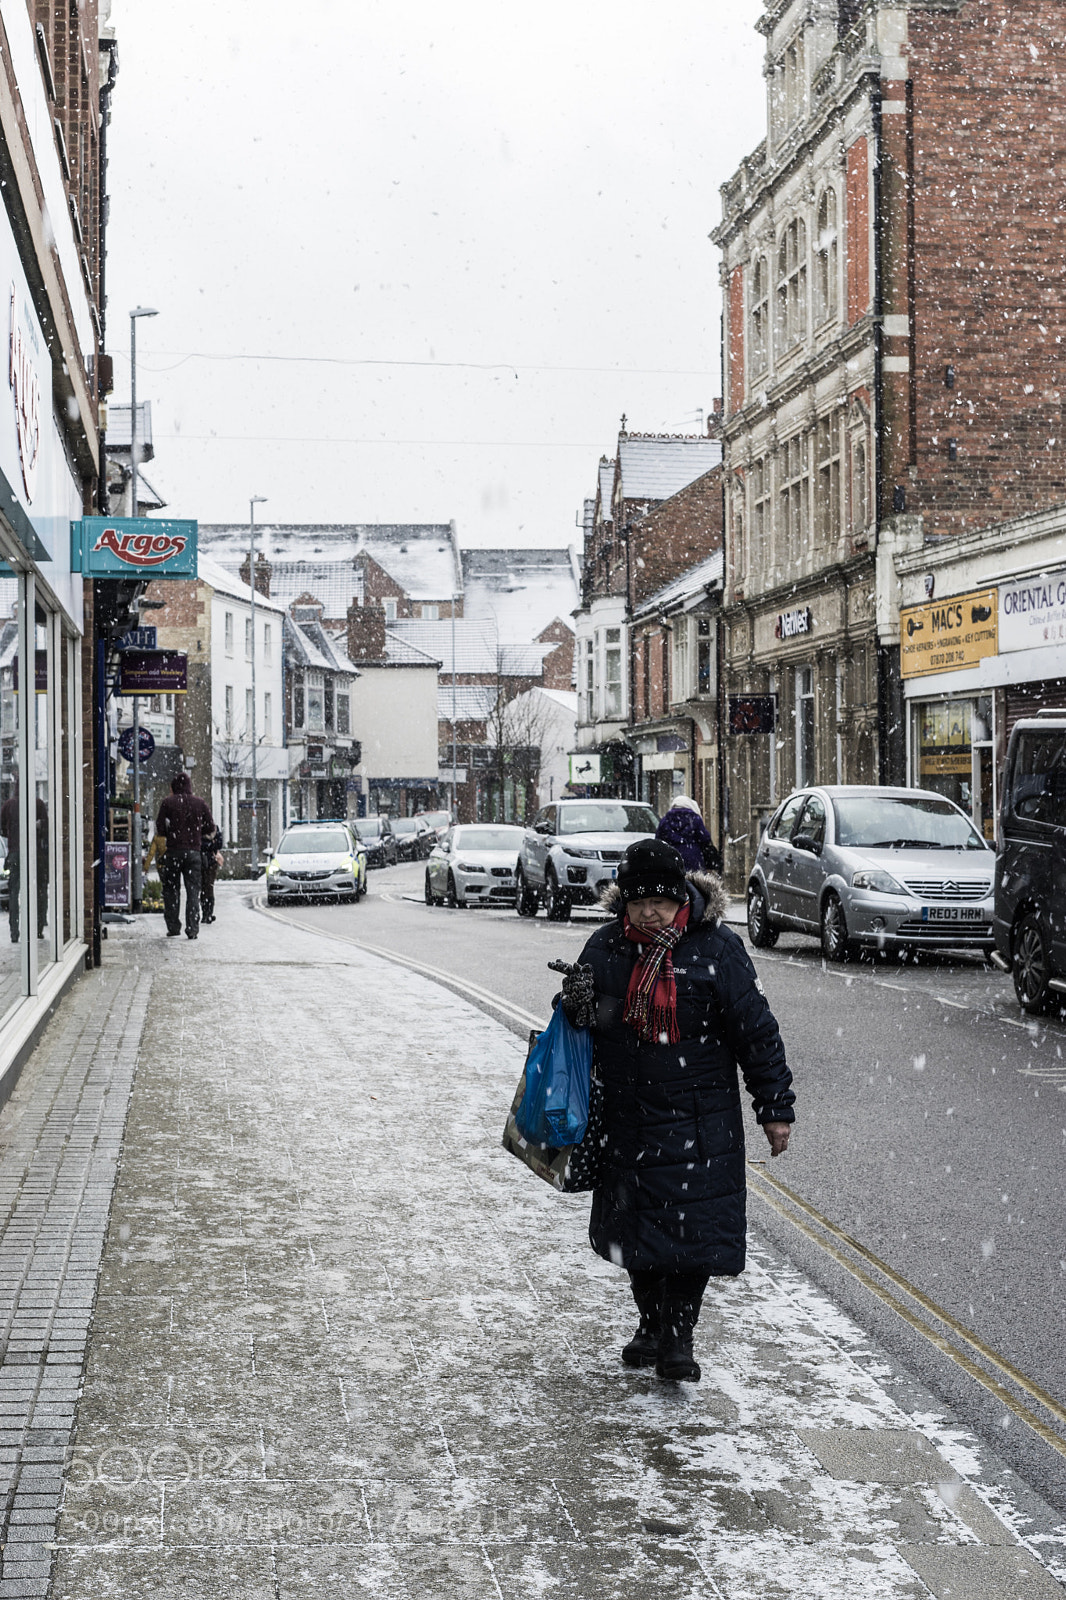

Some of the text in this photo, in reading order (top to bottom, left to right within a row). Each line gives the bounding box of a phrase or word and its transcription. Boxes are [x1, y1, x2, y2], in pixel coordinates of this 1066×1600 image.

[93, 528, 188, 566] Argos
[1004, 584, 1054, 615] ORIENTAL
[781, 607, 809, 639] NatWest
[931, 604, 963, 633] MAC'S
[916, 641, 934, 652] REPAIRS
[965, 633, 974, 644] KEY
[974, 628, 996, 643] CUTTING
[106, 845, 127, 853] Price
[929, 908, 958, 919] RE03
